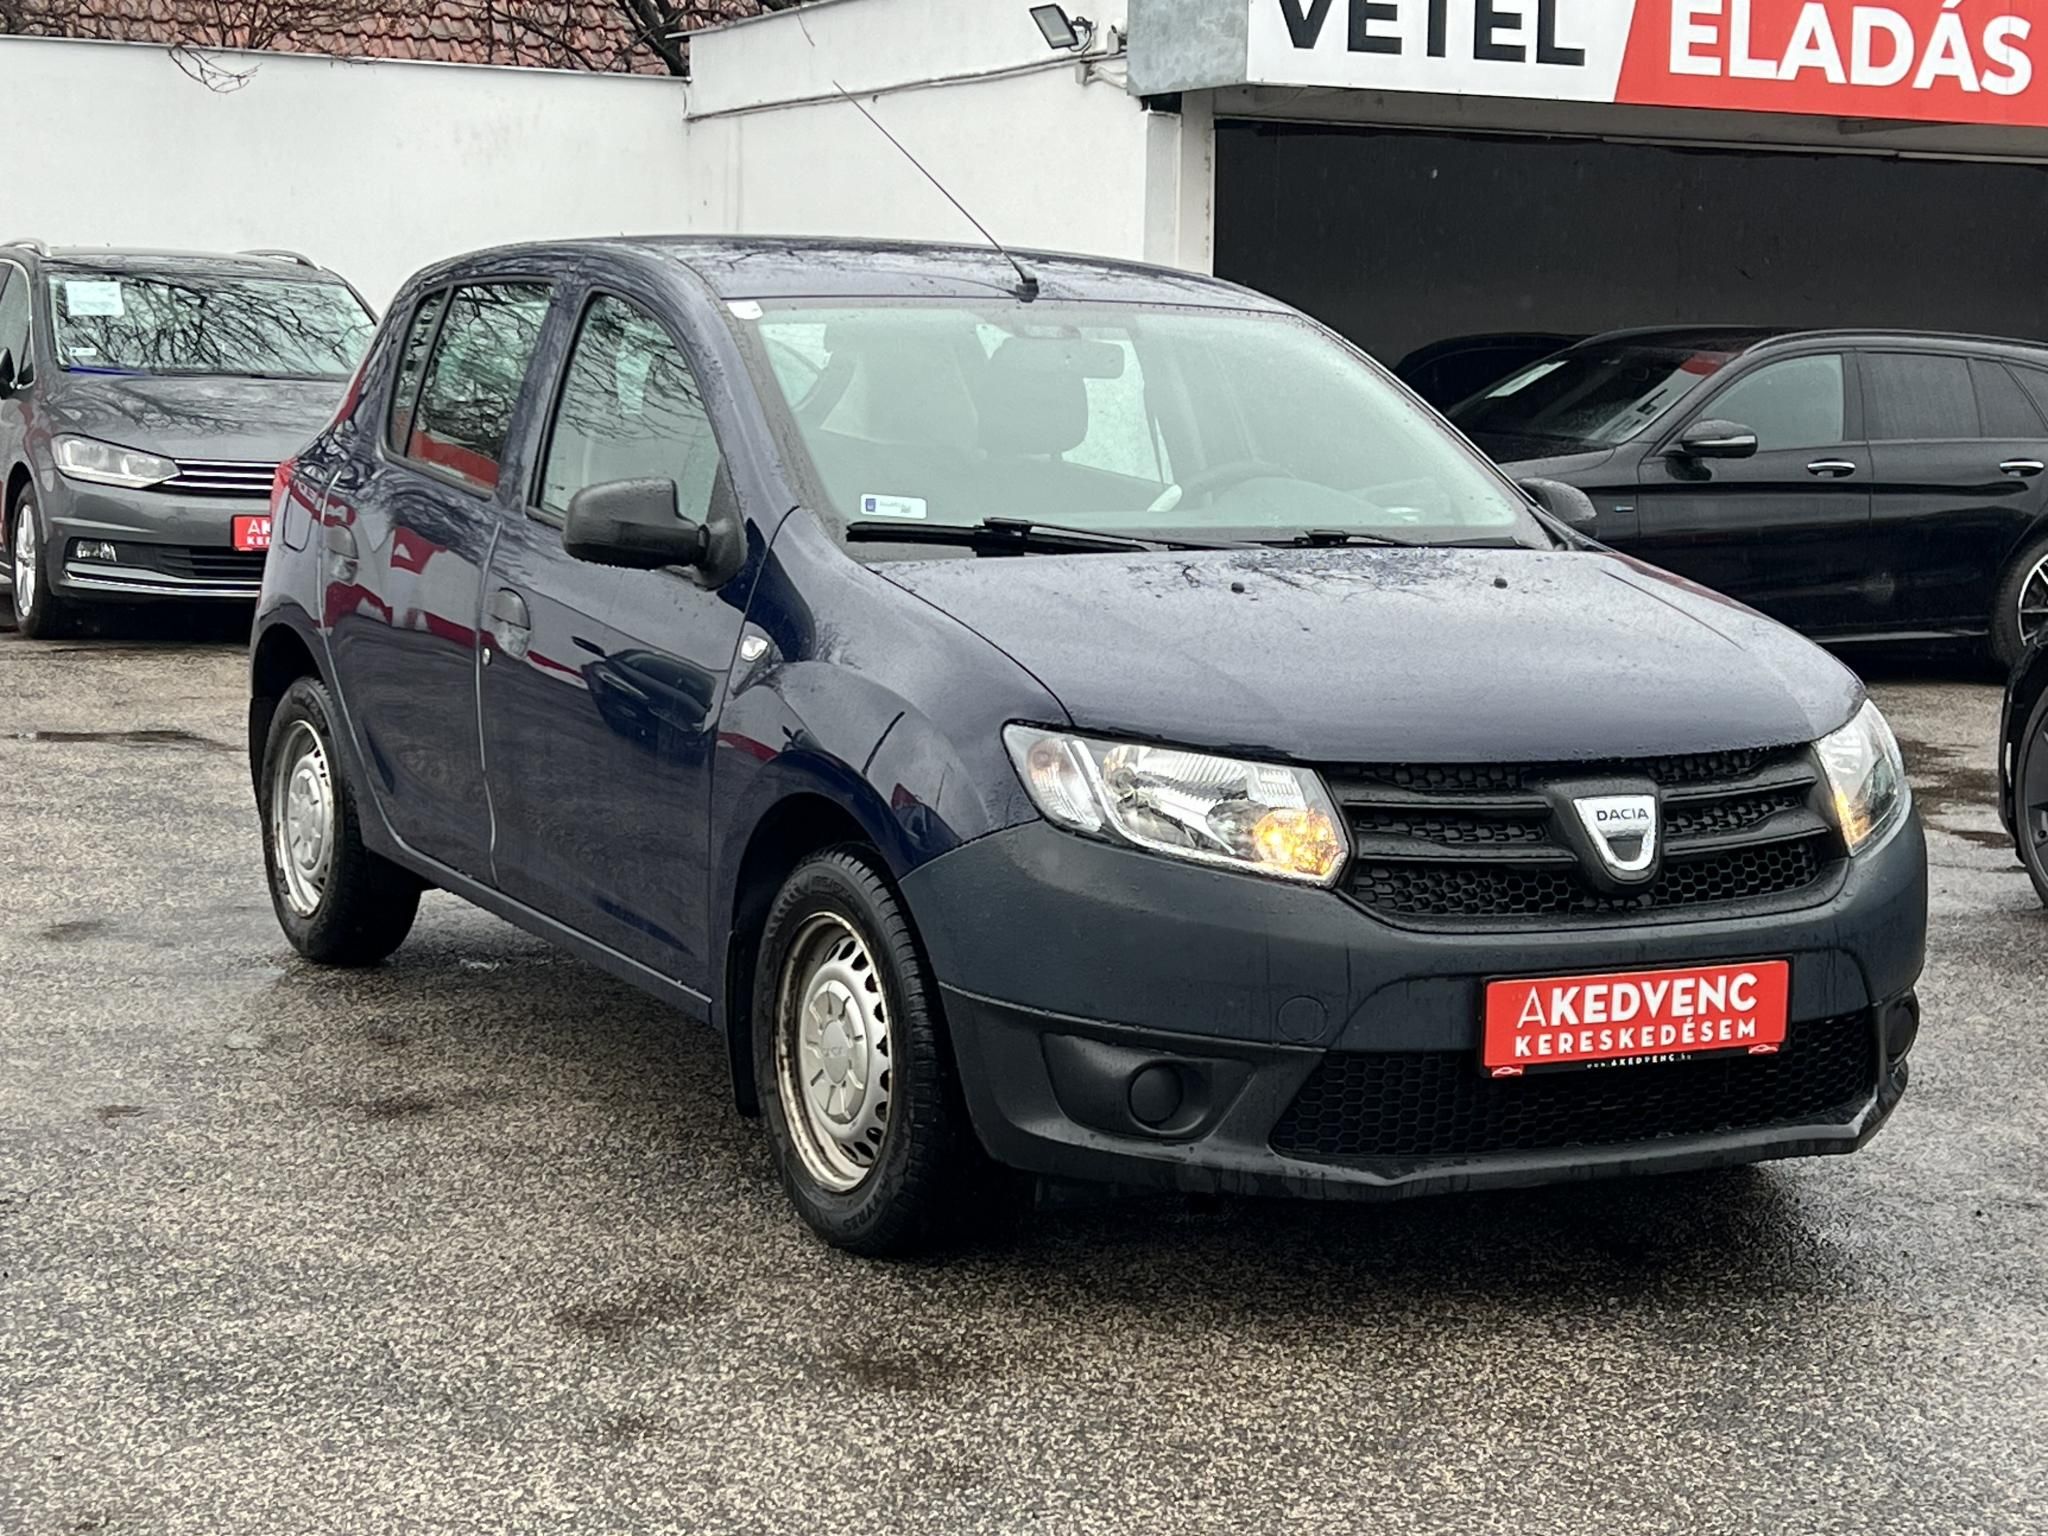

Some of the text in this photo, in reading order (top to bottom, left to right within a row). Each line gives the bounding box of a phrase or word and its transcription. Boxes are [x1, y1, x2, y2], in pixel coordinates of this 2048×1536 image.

[1669, 0, 2033, 95] ELADÁS
[1596, 808, 1649, 821] DACIA
[1514, 1016, 1757, 1057] KERESKEDÉSEM
